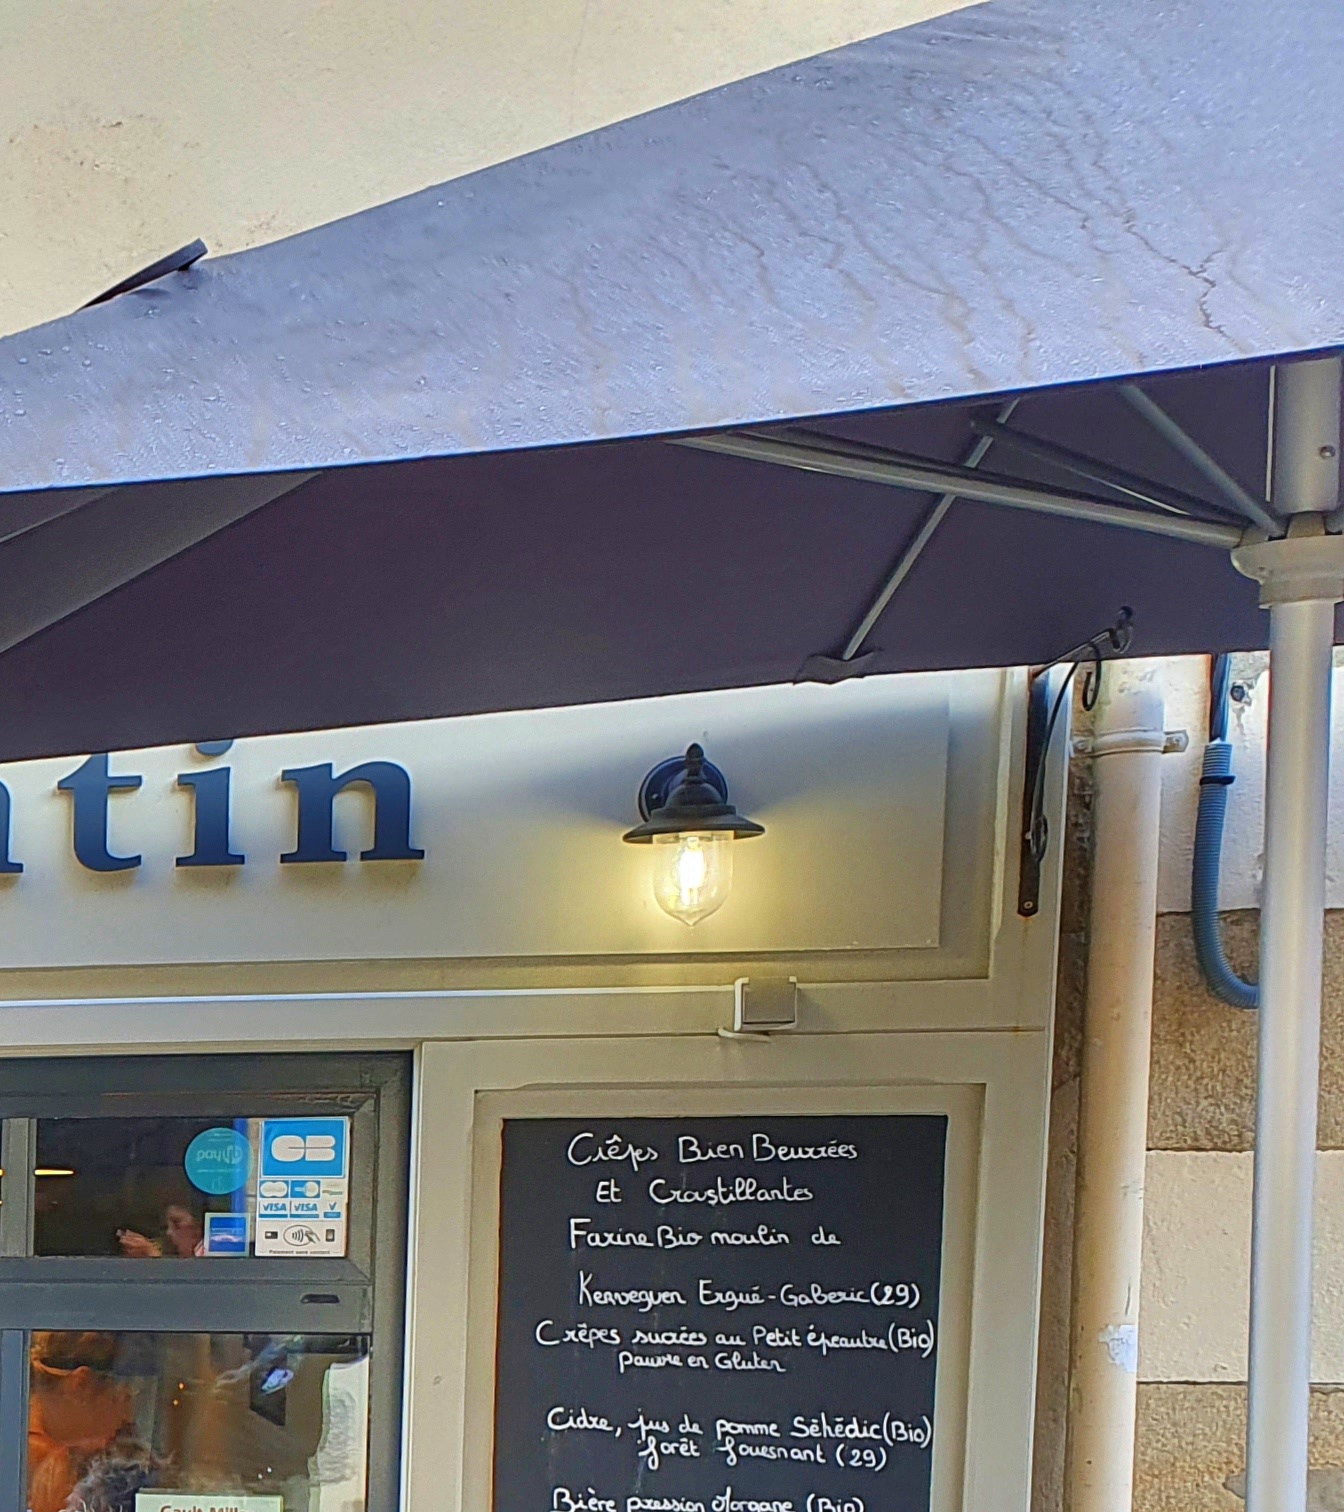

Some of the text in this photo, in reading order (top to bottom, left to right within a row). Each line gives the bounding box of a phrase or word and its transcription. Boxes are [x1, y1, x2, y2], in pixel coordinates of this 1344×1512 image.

[678, 1136, 744, 1163] Bien
[752, 1133, 858, 1161] Beurrées
[596, 1176, 813, 1206] Et Croustillantes
[263, 1203, 287, 1212] VISA
[294, 1203, 318, 1212] VISA
[569, 1218, 841, 1249] Farine Bio moulin de
[535, 1319, 621, 1349] Crêpes
[715, 1333, 747, 1346] au
[752, 1325, 802, 1347] Petit
[687, 1355, 710, 1369] en
[714, 1351, 786, 1372] Gluten
[547, 1406, 622, 1438] Cidre,
[627, 1409, 670, 1439] jus
[678, 1414, 704, 1435] de
[835, 1443, 887, 1472] (29)
